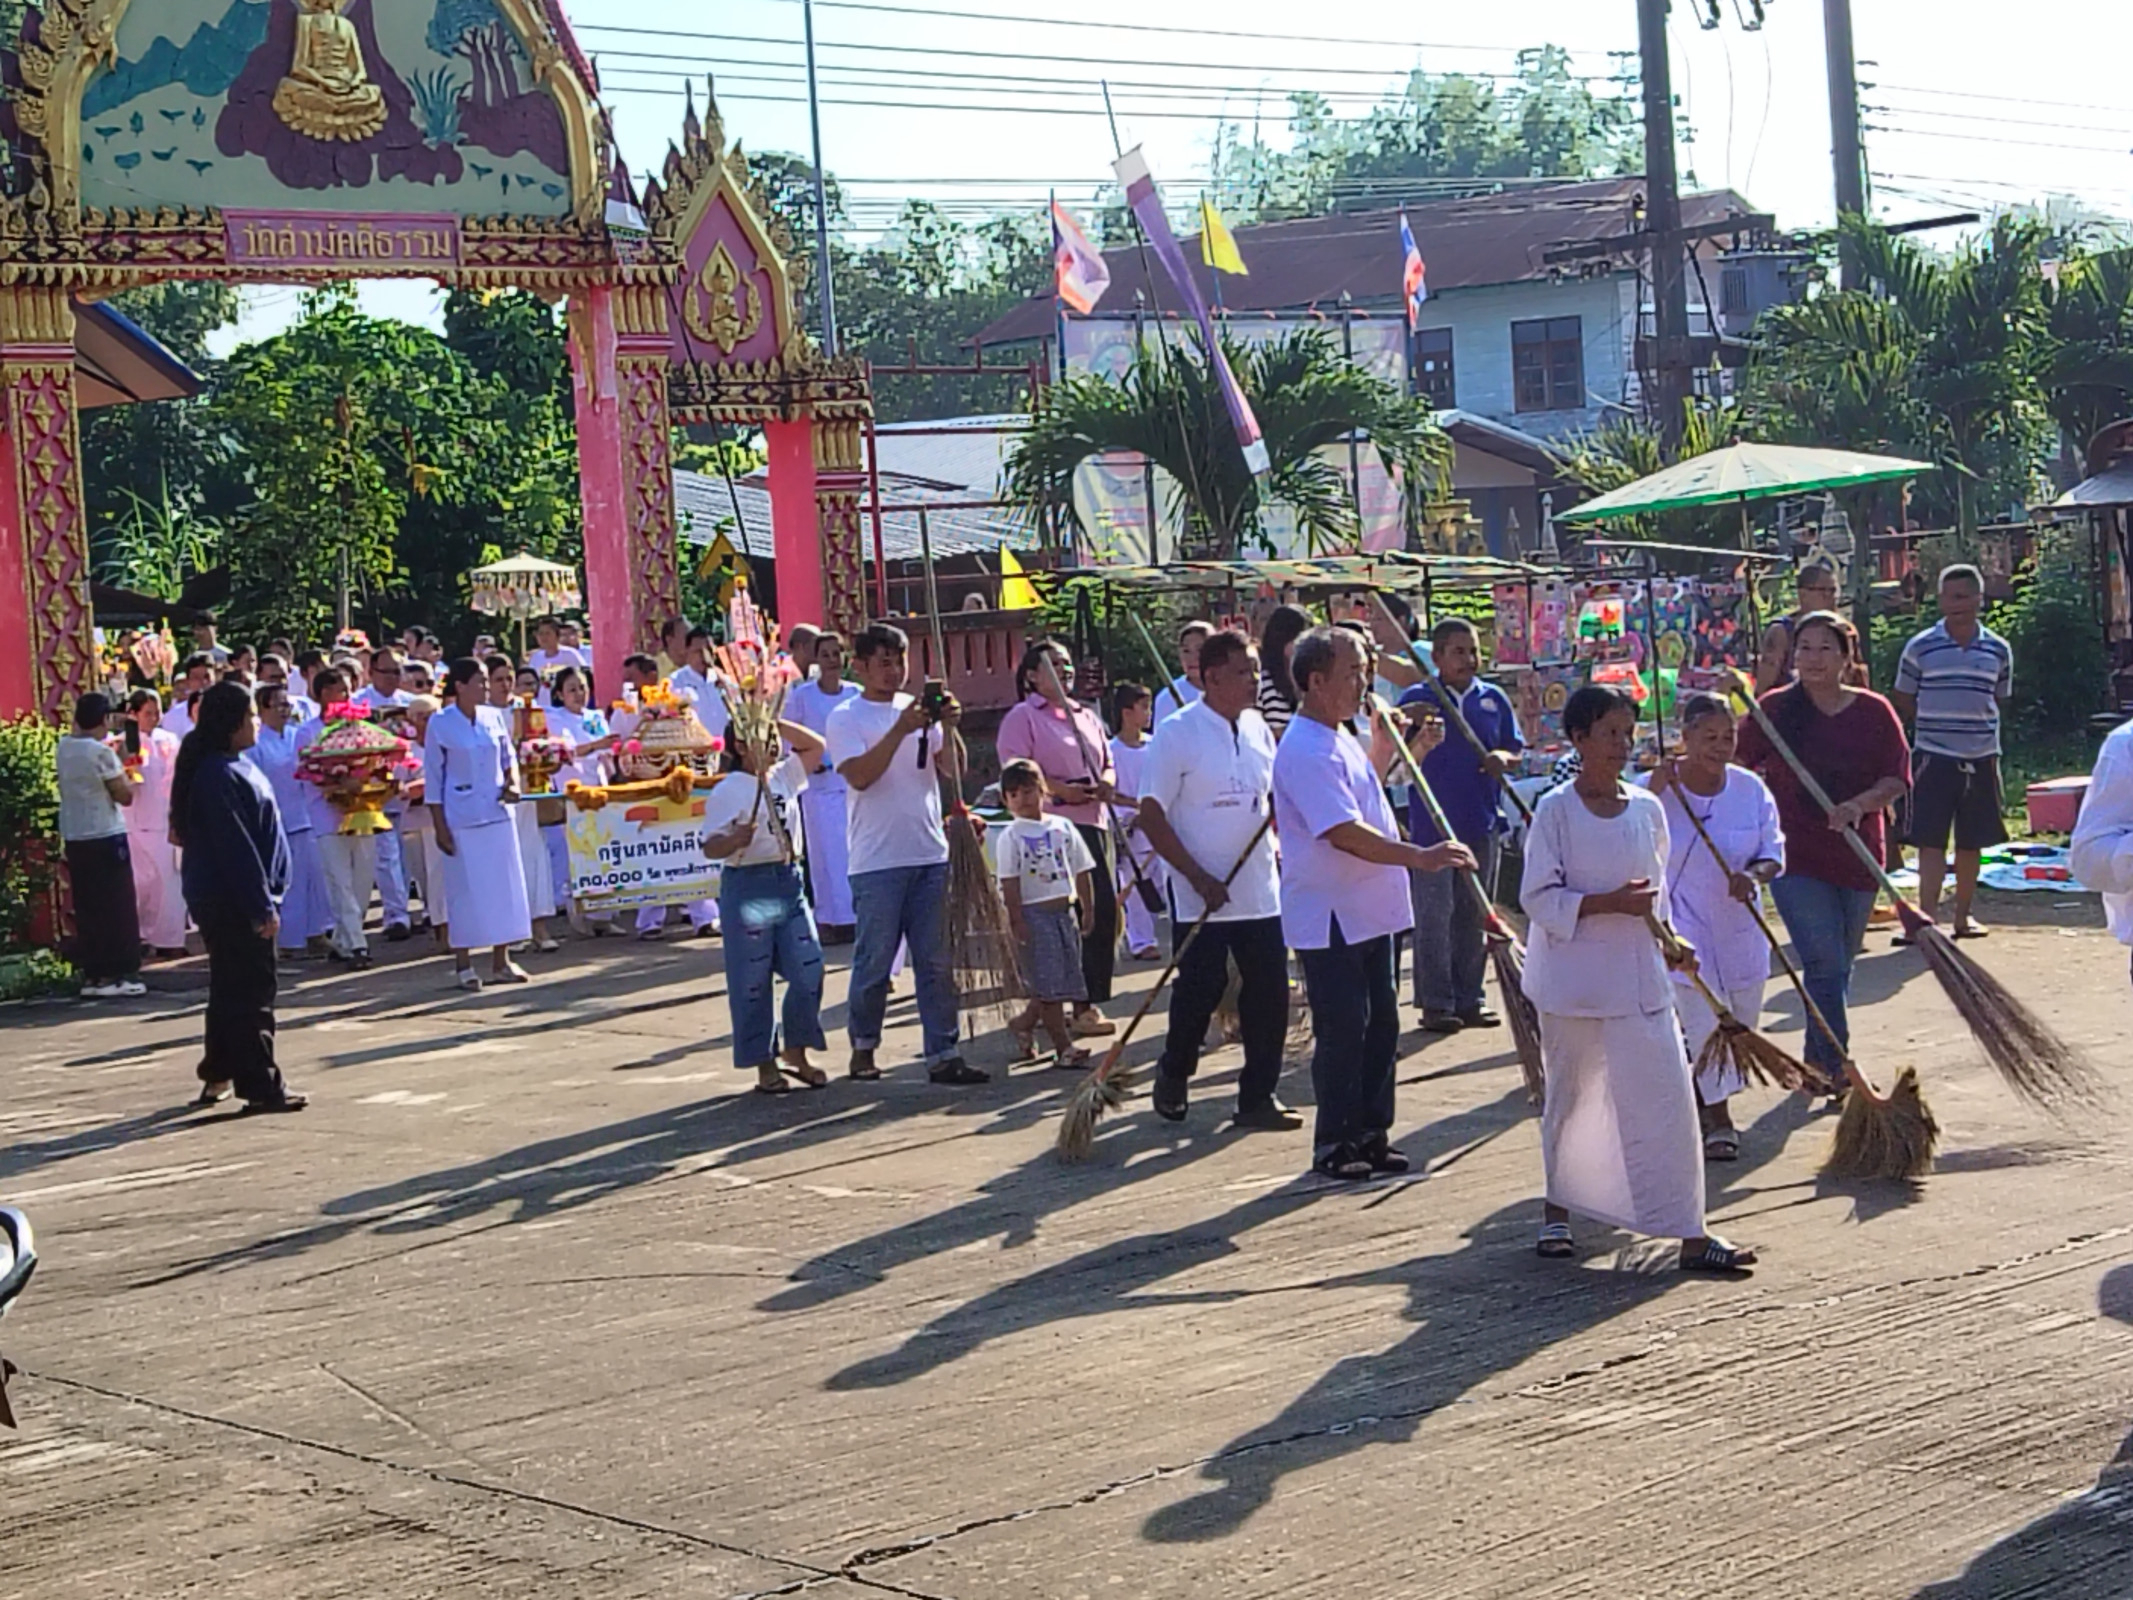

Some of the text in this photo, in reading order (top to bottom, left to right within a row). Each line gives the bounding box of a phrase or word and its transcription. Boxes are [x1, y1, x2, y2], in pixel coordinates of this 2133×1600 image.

[242, 222, 452, 258] วัดสามัคคีธรรม
